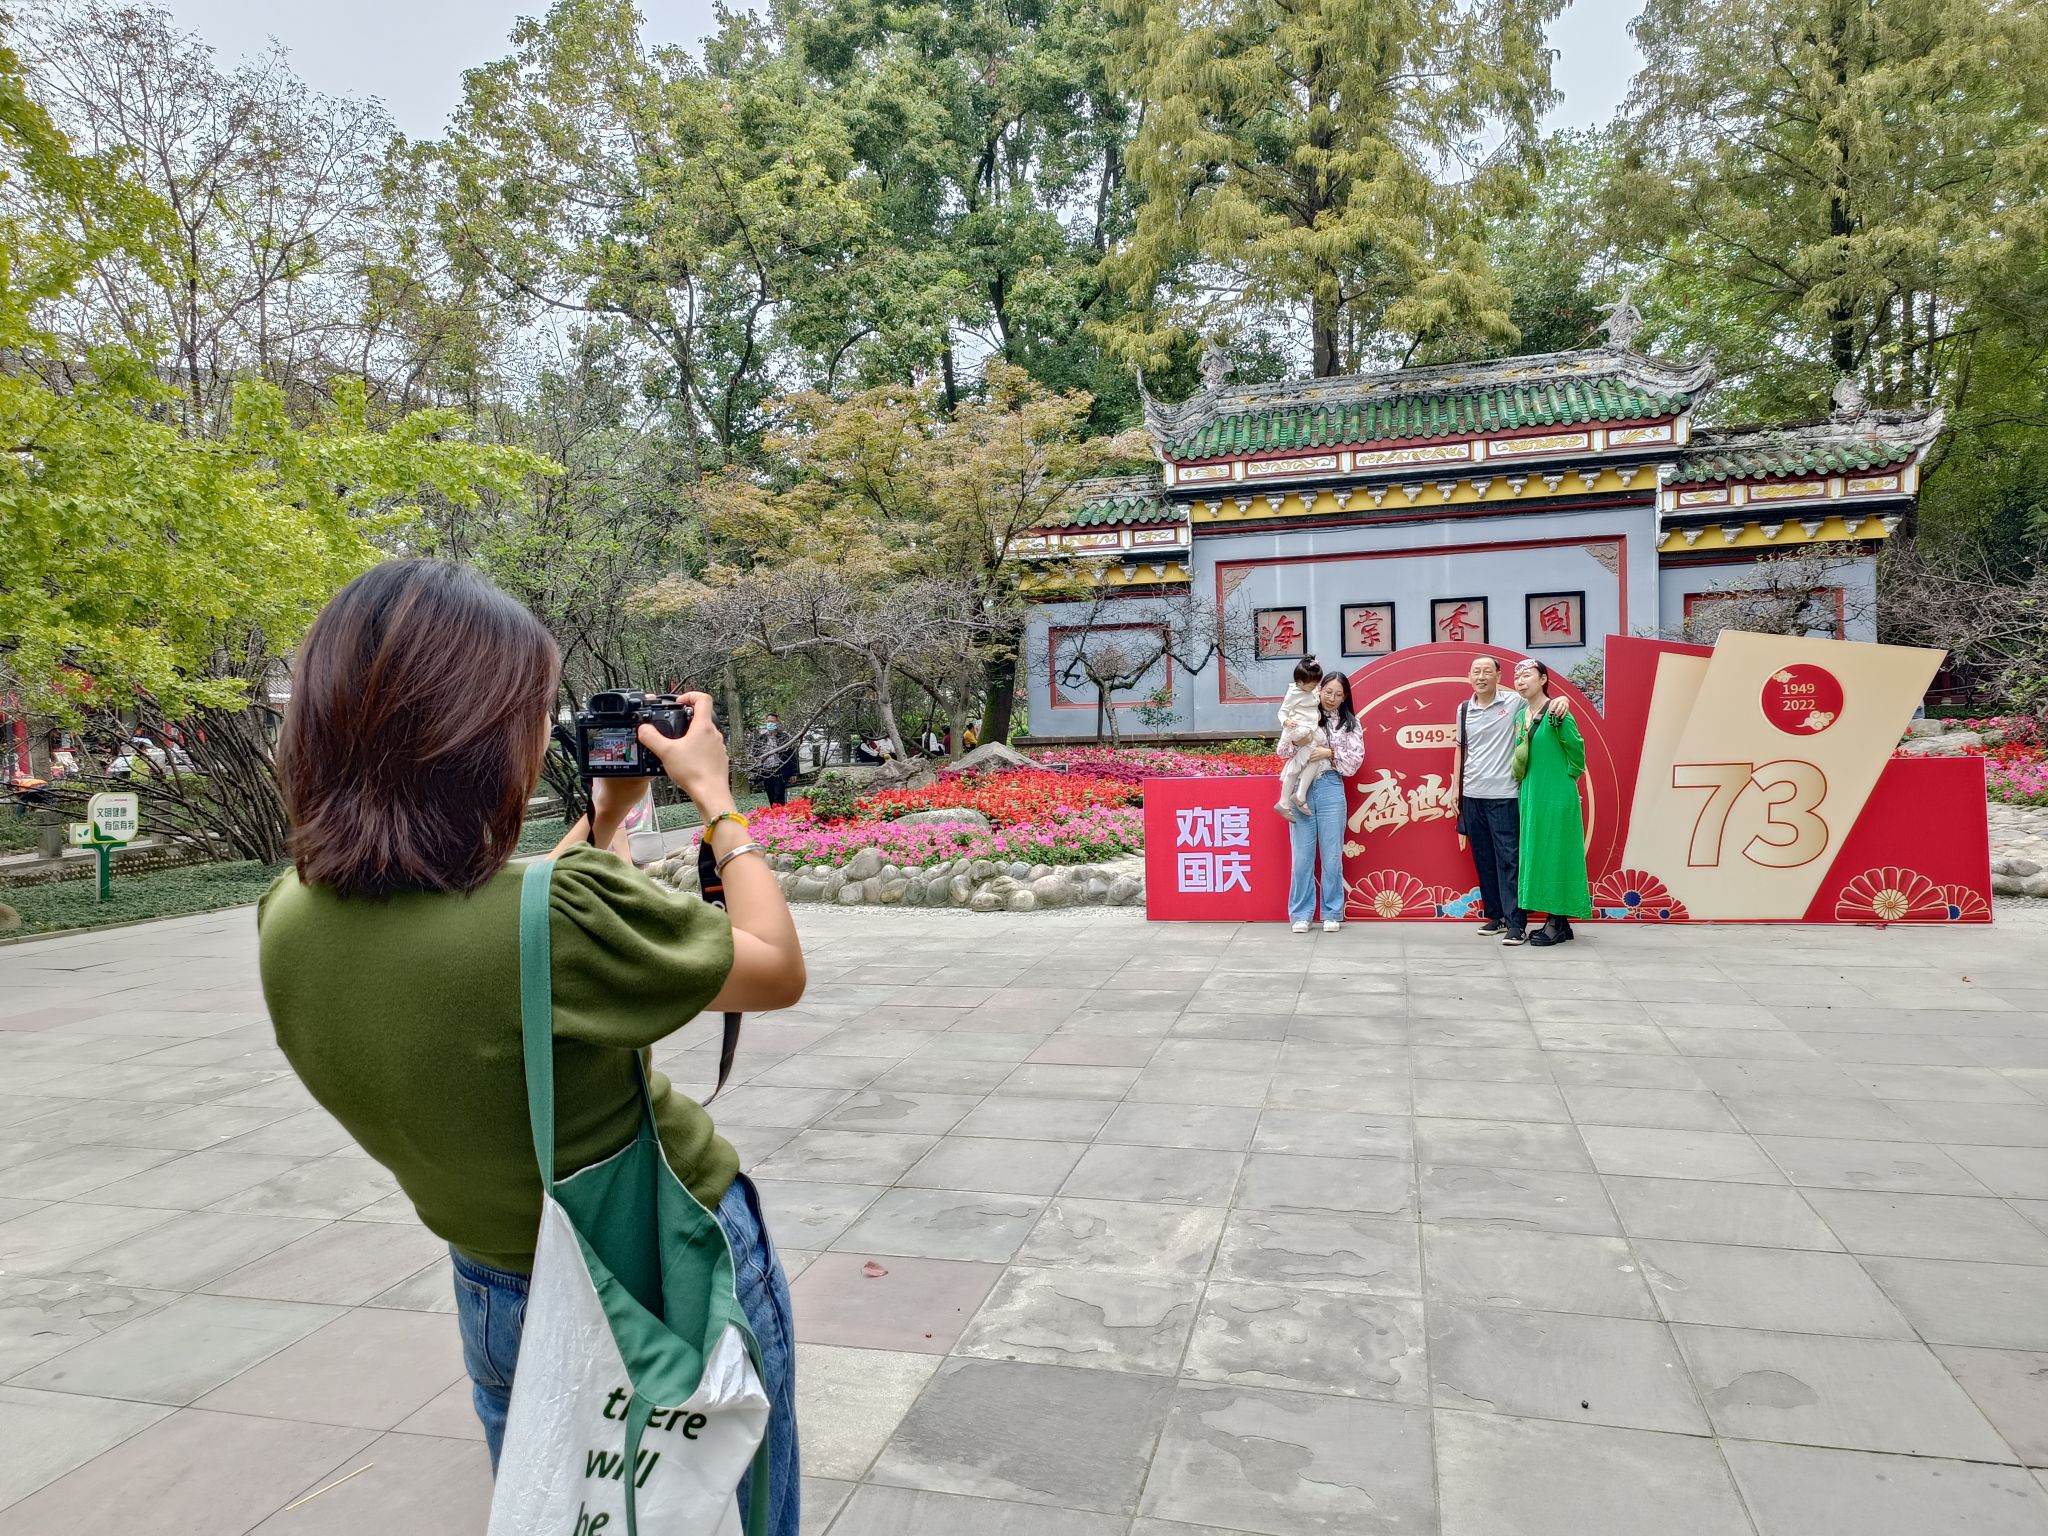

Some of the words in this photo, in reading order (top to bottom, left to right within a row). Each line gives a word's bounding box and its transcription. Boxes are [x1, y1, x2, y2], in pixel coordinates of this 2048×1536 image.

[1782, 683, 1815, 695] 1949
[1782, 699, 1816, 711] 2022
[1176, 806, 1250, 848] 欢度
[1672, 759, 1829, 868] 73
[1177, 851, 1252, 893] 国庆
